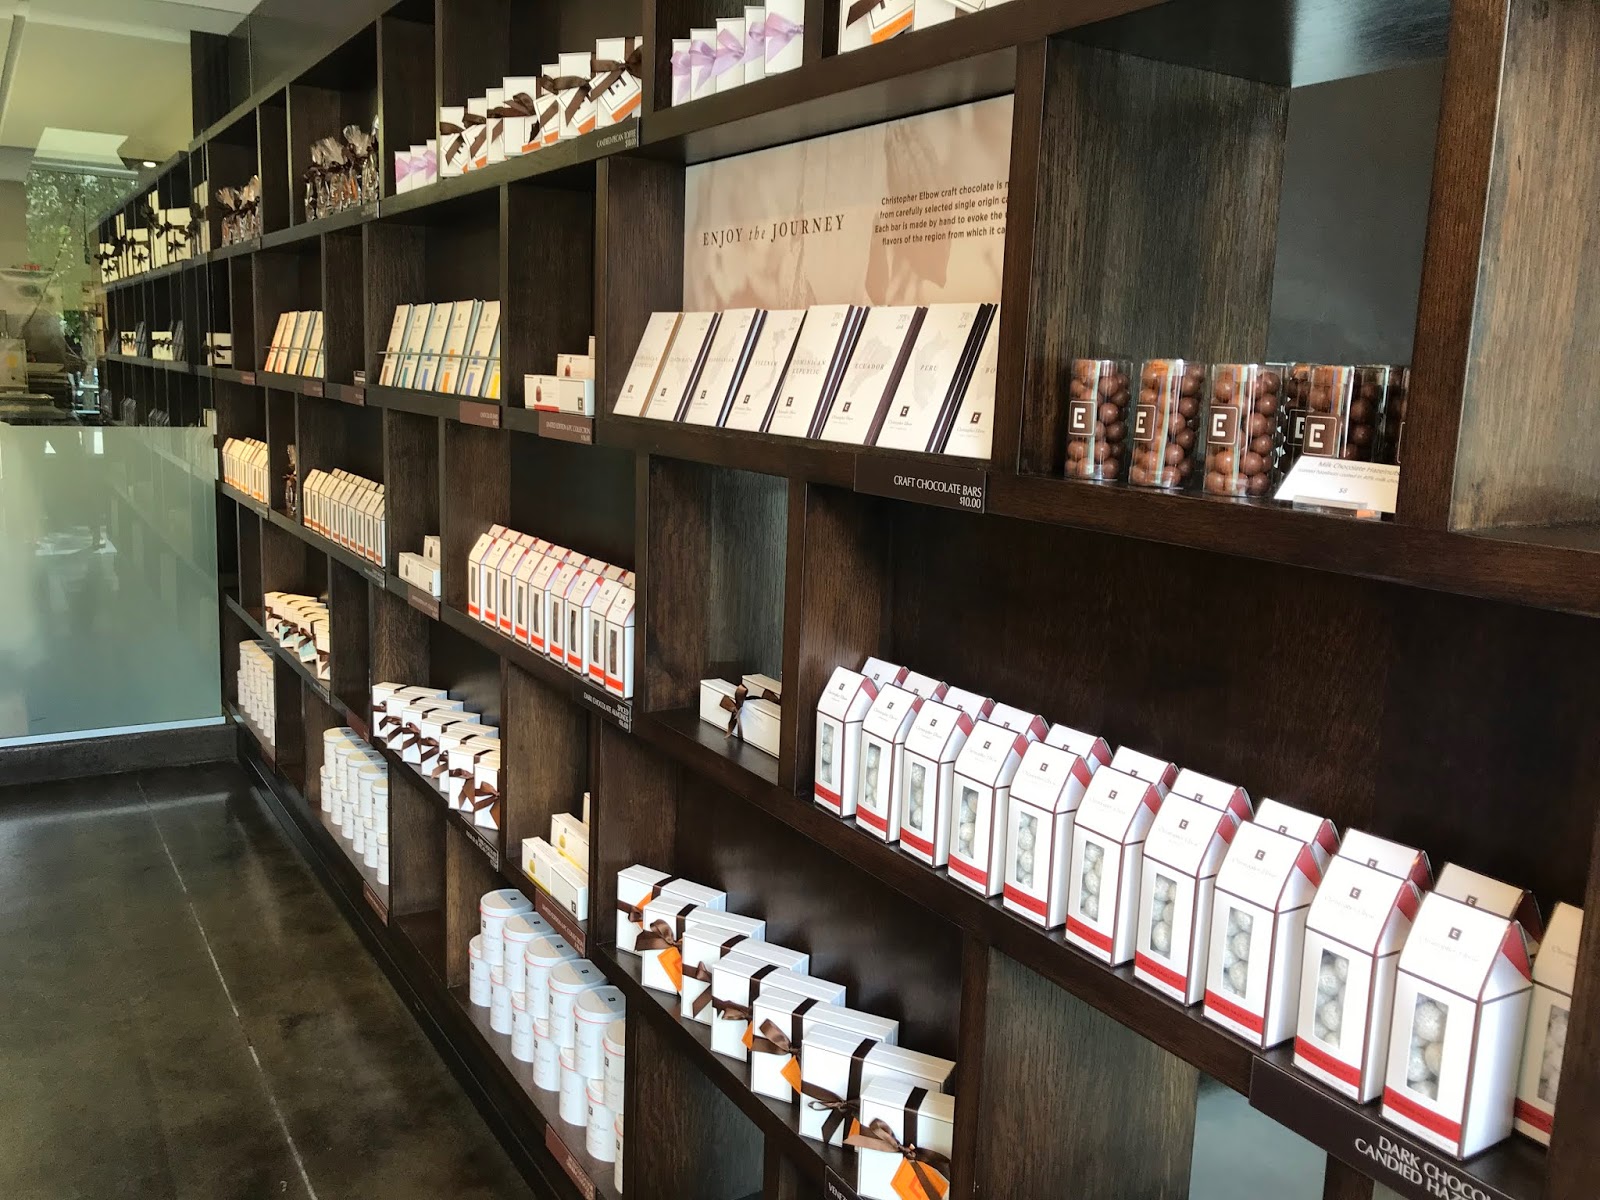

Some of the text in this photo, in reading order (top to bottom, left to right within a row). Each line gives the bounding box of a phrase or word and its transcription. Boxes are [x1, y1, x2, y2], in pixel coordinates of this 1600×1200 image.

[882, 196, 917, 205] Christopher
[919, 192, 939, 201] Elbow
[941, 187, 957, 199] craft
[959, 182, 994, 195] chocolate
[996, 181, 1002, 190] is
[880, 210, 894, 219] from
[896, 205, 922, 217] carefully
[925, 202, 952, 212] selected
[954, 199, 976, 211] single
[978, 196, 999, 207] origin
[703, 214, 844, 248] ENJOY the JOURNEY
[875, 224, 889, 233] Each
[890, 222, 901, 231] bar
[902, 221, 908, 230] is
[910, 219, 928, 229] made
[929, 218, 937, 228] by
[938, 216, 956, 226] hand
[967, 212, 988, 222] evoke
[990, 211, 1002, 220] the
[882, 235, 902, 245] flavors
[904, 234, 911, 243] of
[913, 233, 923, 242] the
[924, 231, 946, 243] region
[948, 230, 964, 240] from
[966, 228, 987, 238] which
[989, 226, 995, 235] it
[1072, 407, 1086, 429] E
[1135, 412, 1147, 433] E
[1212, 414, 1228, 437] E
[1308, 424, 1325, 448] E
[893, 475, 982, 498] CRAFT CHOCOLATE BARS
[959, 496, 982, 509] $10.00
[1354, 1138, 1423, 1185] CANDIED
[1379, 1135, 1421, 1169] DARK
